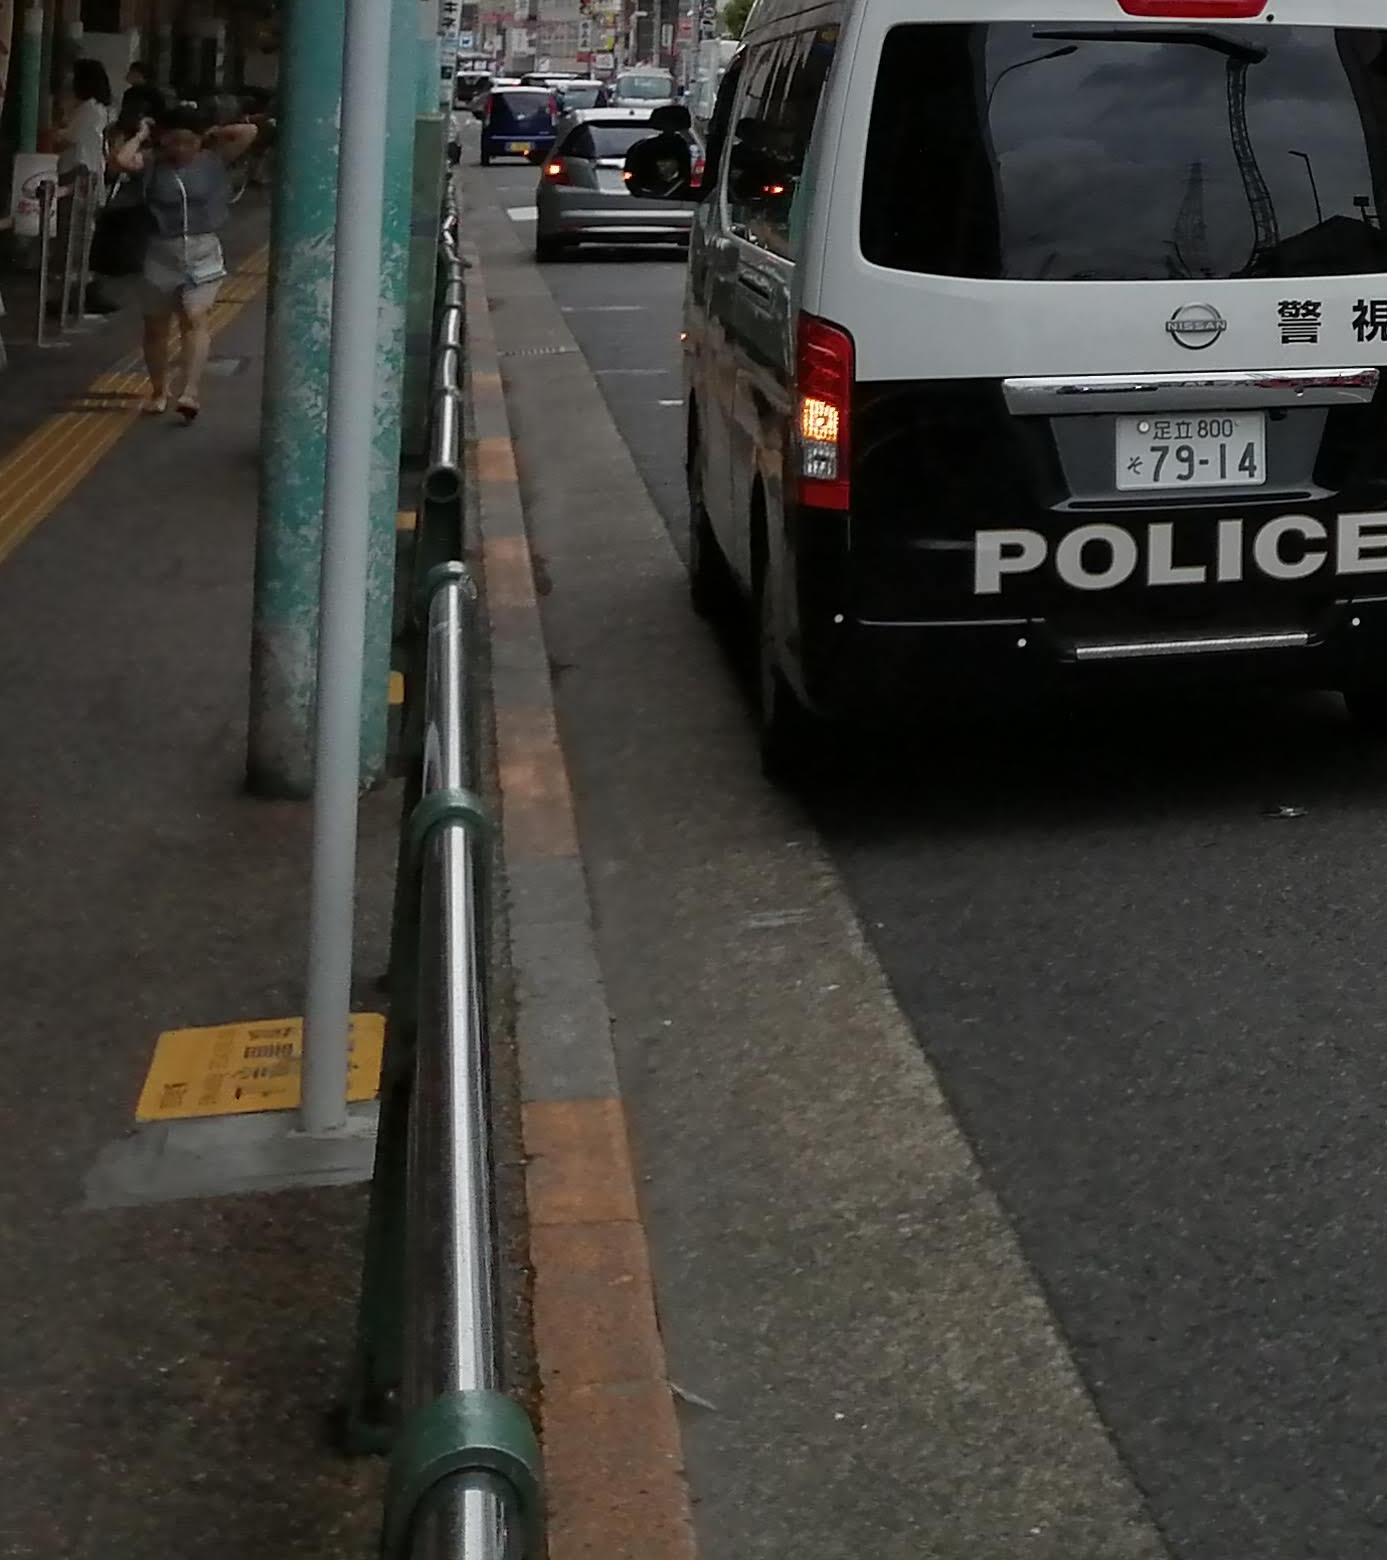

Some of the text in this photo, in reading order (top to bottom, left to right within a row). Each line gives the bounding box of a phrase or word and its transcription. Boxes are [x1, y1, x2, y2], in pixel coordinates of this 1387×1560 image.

[1166, 320, 1226, 332] NISSAN
[1153, 418, 1233, 440] 足立 800
[1127, 442, 1257, 482] そ 79-14
